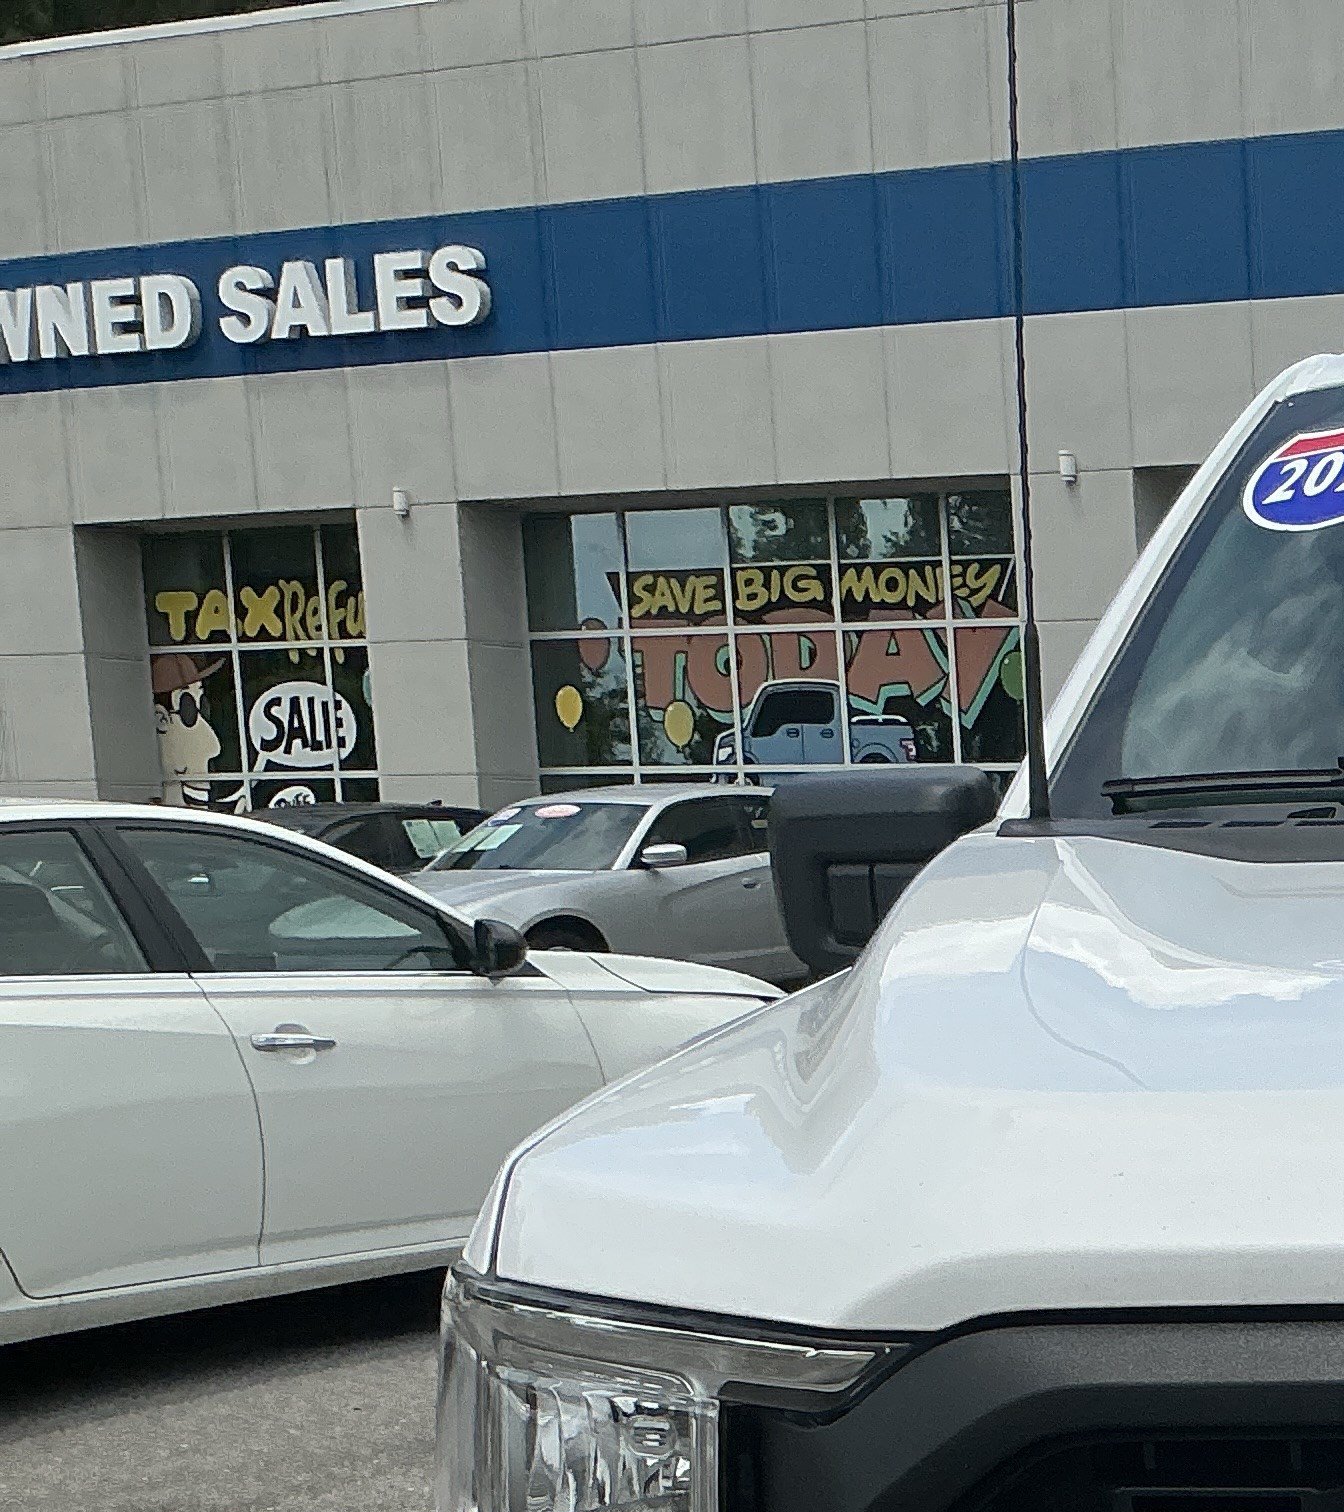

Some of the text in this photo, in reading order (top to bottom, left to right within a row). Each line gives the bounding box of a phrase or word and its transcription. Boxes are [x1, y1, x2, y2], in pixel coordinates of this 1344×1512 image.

[219, 245, 492, 346] SALES
[155, 586, 283, 641] TAX
[631, 562, 1001, 618] SAVE BIG MONEY
[631, 599, 1019, 729] TODAY
[260, 695, 347, 755] SALE
